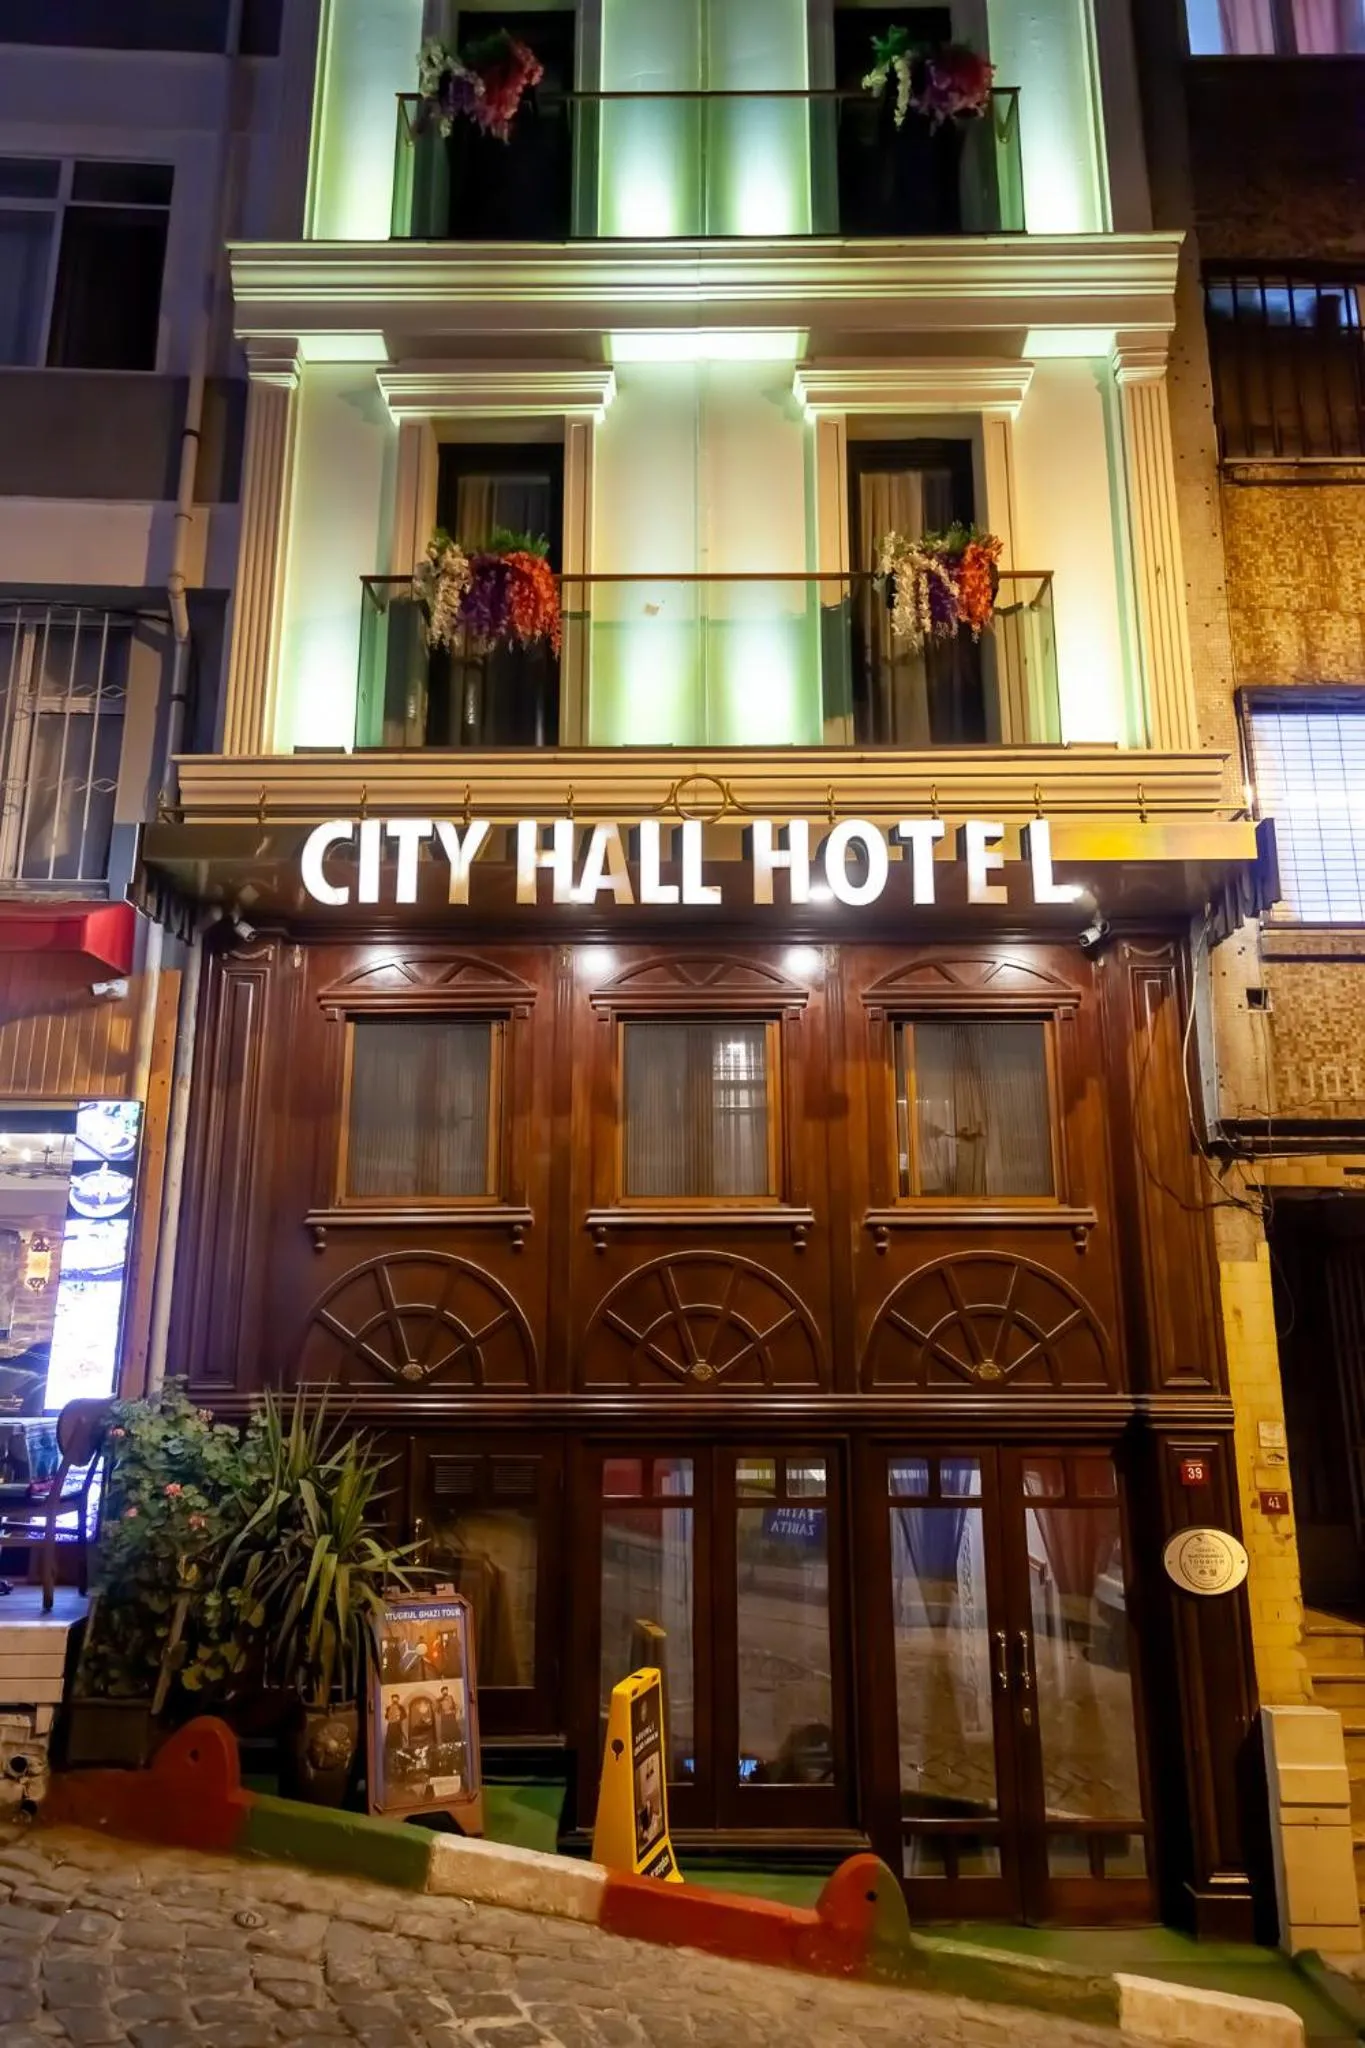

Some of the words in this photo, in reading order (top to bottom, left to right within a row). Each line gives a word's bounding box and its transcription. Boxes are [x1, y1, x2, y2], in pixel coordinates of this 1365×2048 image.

[301, 820, 492, 906] CITY
[517, 820, 723, 907] HALL
[753, 820, 1074, 906] HOTEL
[1187, 1467, 1203, 1480] 39
[1267, 1496, 1281, 1509] 41
